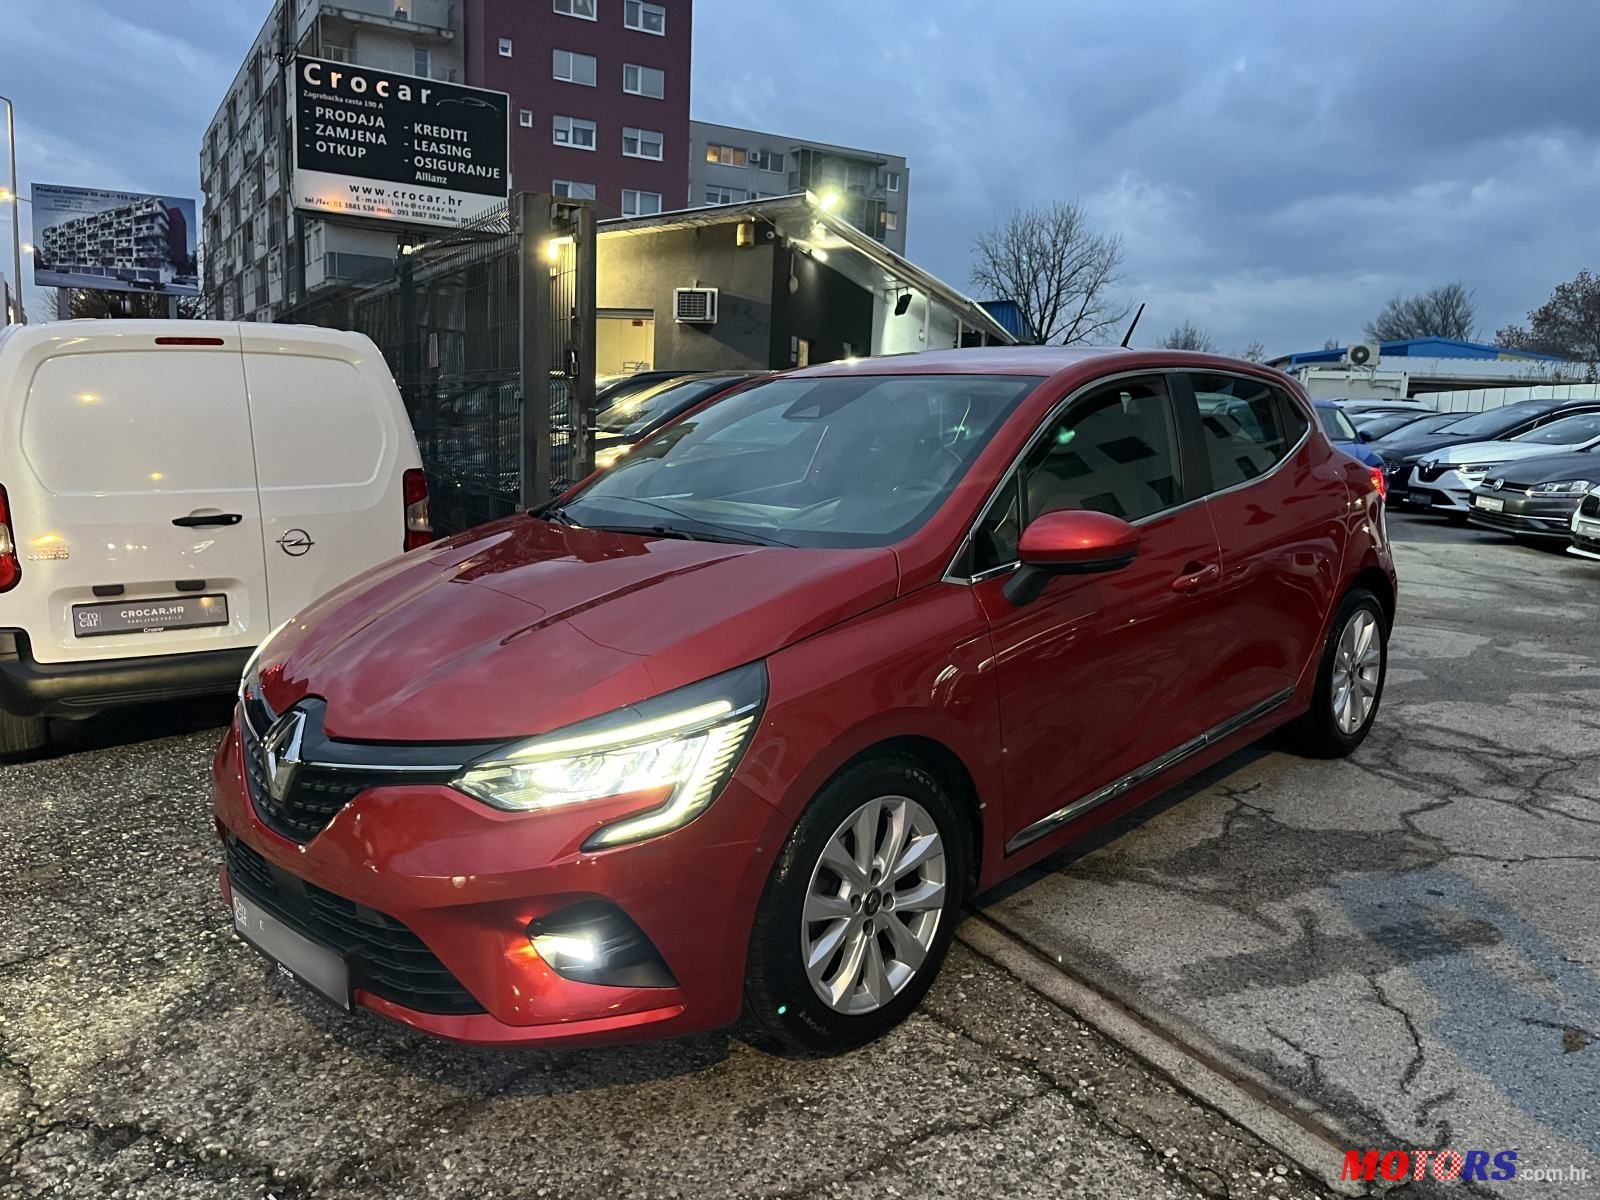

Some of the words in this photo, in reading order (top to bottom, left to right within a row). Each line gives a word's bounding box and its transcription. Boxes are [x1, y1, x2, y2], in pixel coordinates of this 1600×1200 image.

[303, 63, 431, 104] Crocar
[315, 106, 385, 129] PRODAJA
[315, 123, 387, 145] ZAMJENA
[413, 122, 468, 143] KREDITI
[315, 140, 367, 159] OTKUP
[413, 139, 472, 159] LEASING
[413, 156, 500, 179] OSIGURANJE
[415, 171, 448, 185] Allianz
[349, 184, 463, 207] www.crocar.hr
[120, 605, 185, 618] CROCAR.HR
